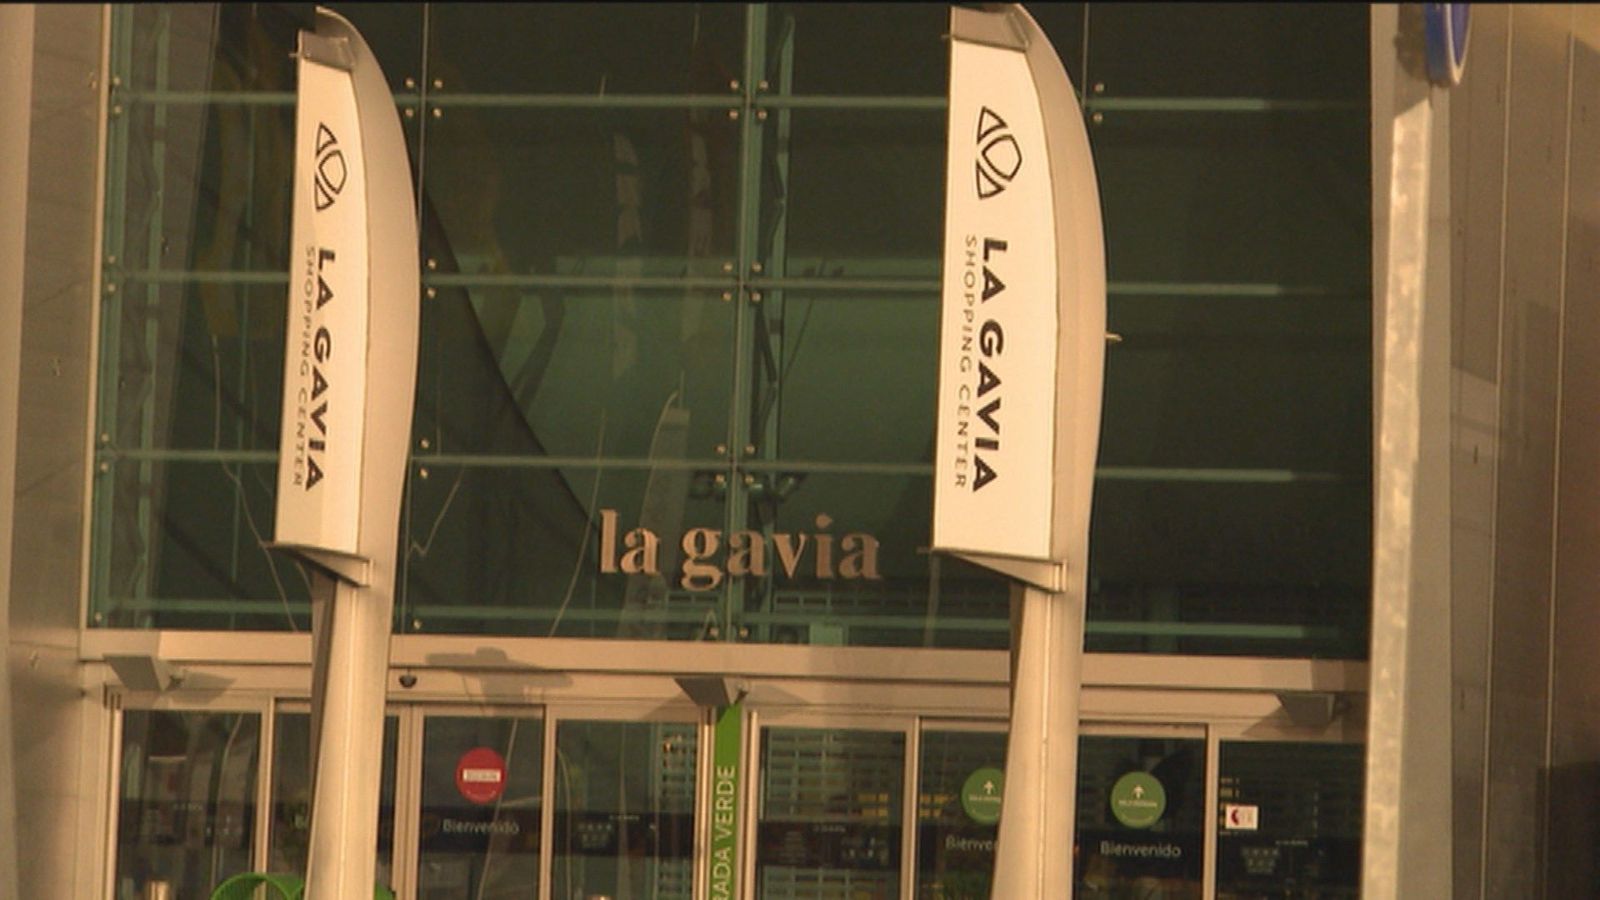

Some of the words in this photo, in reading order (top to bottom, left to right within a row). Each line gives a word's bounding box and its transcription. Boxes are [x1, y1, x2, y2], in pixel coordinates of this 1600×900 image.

[301, 246, 315, 375] SHOPPING
[317, 248, 335, 310] LA
[960, 234, 977, 373] SHOPPING
[982, 238, 1008, 303] LA
[293, 387, 308, 486] CENTER
[305, 326, 331, 492] GAVIA
[955, 384, 971, 488] CENTER
[973, 319, 1004, 492] GAVIA
[599, 508, 661, 575] la
[680, 512, 881, 592] gavia
[442, 818, 521, 836] Bienvenido
[714, 765, 736, 841] VERDE
[945, 834, 997, 852] Bienve
[1100, 840, 1182, 859] Bienvenido
